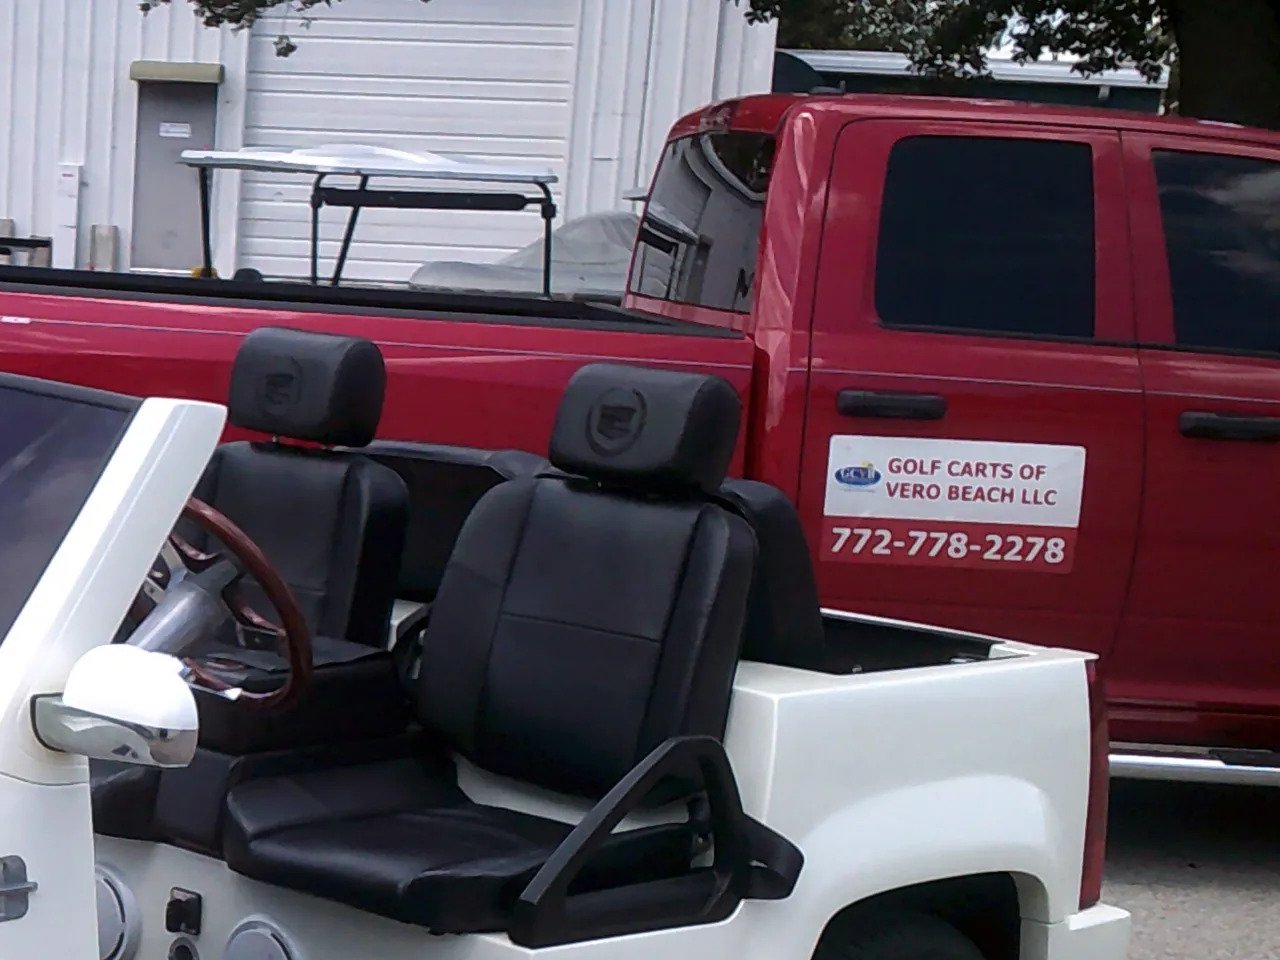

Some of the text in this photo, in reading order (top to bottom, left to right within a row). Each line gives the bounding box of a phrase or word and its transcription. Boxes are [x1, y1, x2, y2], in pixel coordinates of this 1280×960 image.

[888, 458, 1047, 481] GOLF CARTS OF
[886, 482, 1058, 506] VERO BEACH LLC
[831, 527, 1066, 564] 772-778-2278
